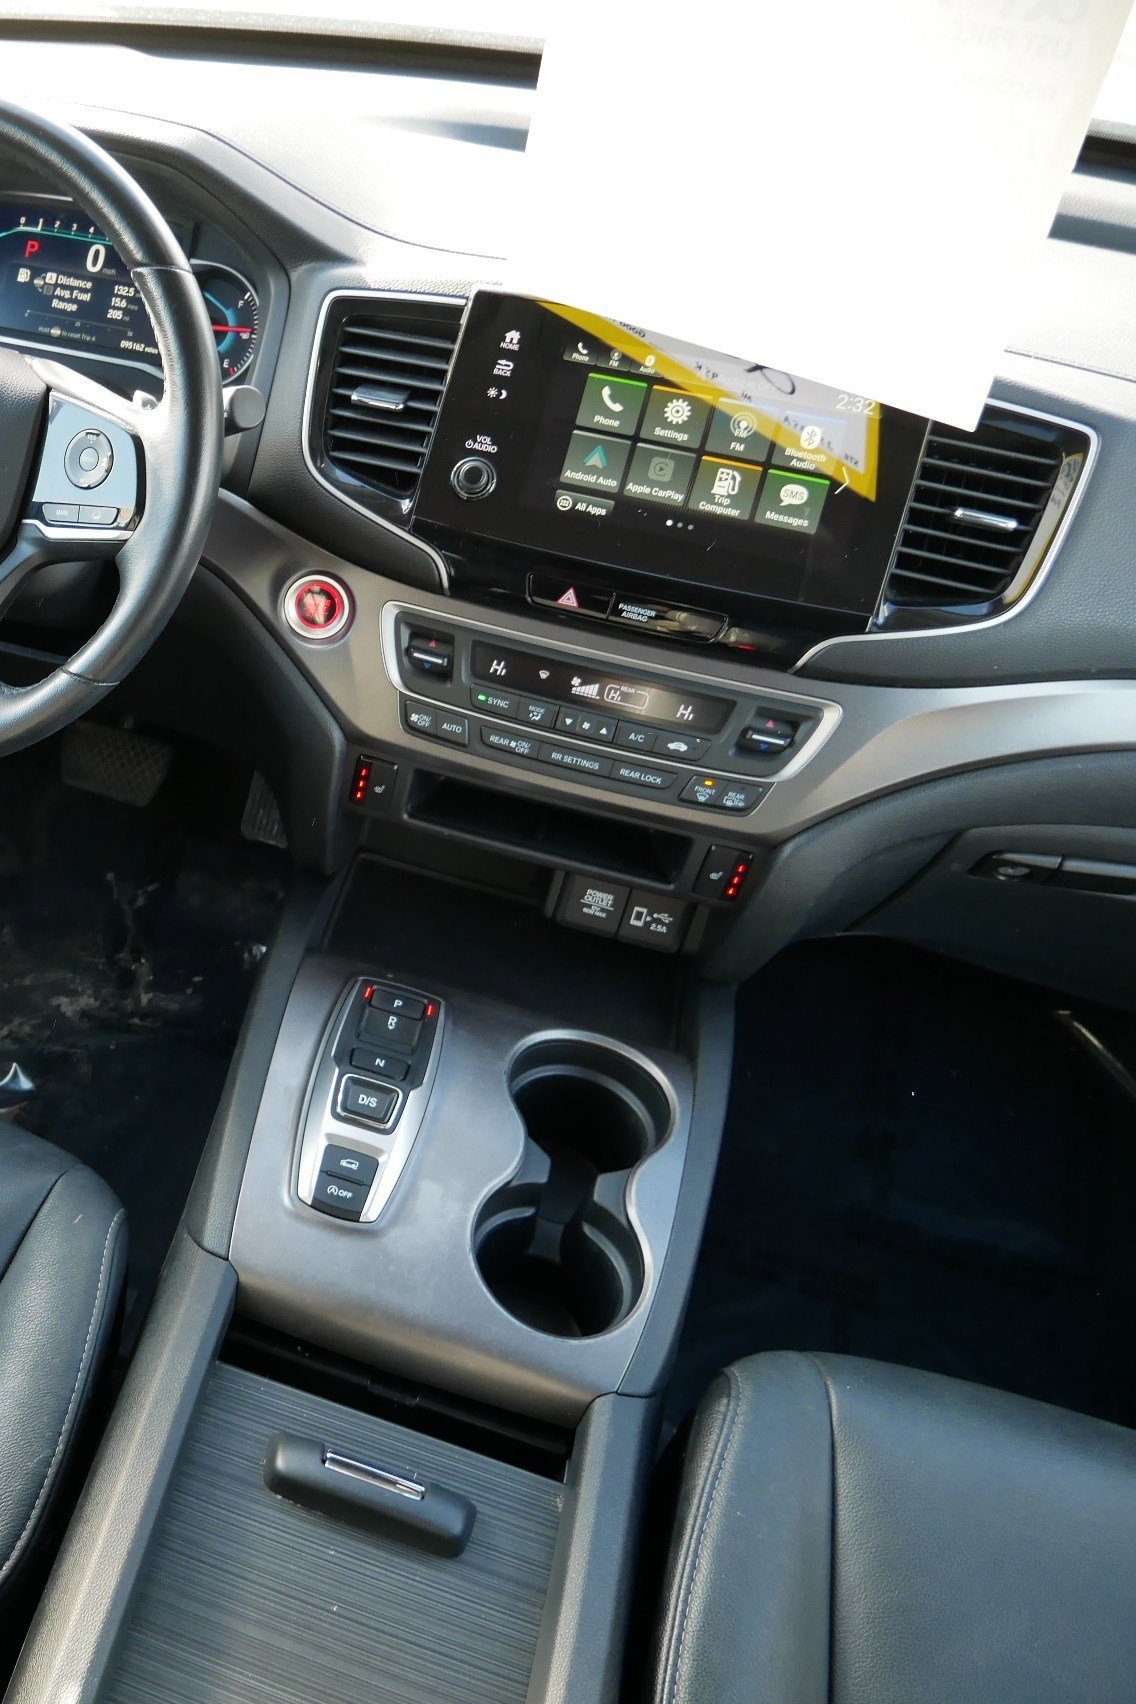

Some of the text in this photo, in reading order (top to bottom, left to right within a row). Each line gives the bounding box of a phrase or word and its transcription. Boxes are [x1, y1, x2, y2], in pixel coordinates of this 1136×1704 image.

[25, 240, 40, 258] P
[86, 244, 106, 273] 0
[57, 275, 93, 289] Distance
[114, 285, 135, 297] 132.5
[54, 287, 71, 299] Avg.
[72, 290, 91, 301] Fuel
[111, 297, 127, 308] 15.6
[52, 299, 78, 311] Range
[107, 309, 123, 320] 205
[238, 300, 244, 309] F
[120, 340, 145, 352] 095162
[500, 341, 520, 351] HOME
[571, 352, 590, 362] Phone
[223, 358, 229, 368] E
[608, 360, 619, 368] FM
[493, 368, 511, 377] BACK
[639, 365, 656, 374] Audio
[836, 394, 875, 415] 2:32
[593, 415, 620, 427] Phone
[654, 427, 689, 441] Settings
[476, 435, 492, 445] VOL
[472, 442, 498, 453] AUDIO
[729, 442, 745, 452] FM
[784, 447, 826, 462] Bluetooth
[790, 459, 816, 470] Audio
[564, 469, 617, 487] Android Auto
[626, 482, 684, 502] Apple CarPlay
[784, 489, 804, 501] SMS
[714, 495, 731, 506] Trip
[575, 502, 606, 516] All Apps
[699, 501, 740, 517] Computer
[765, 511, 809, 527] Messages
[618, 603, 656, 618] PASSENGER
[621, 611, 648, 622] AIRBAG
[621, 686, 636, 694] REAR
[487, 697, 509, 708] SYNC
[528, 705, 545, 714] MODE
[417, 720, 430, 728] OFF
[442, 722, 462, 734] AUTO
[489, 735, 509, 746] REAR
[628, 733, 645, 743] A/C
[515, 746, 530, 755] OFF
[551, 752, 600, 770] RR SETTINGS
[619, 768, 663, 784] REAR LOCK
[695, 785, 715, 795] FRONT
[728, 791, 745, 800] REAR
[587, 889, 614, 900] POWER
[584, 894, 612, 907] OUTLET
[650, 923, 667, 933] 2.5A
[393, 999, 402, 1009] P
[388, 1015, 397, 1026] R
[375, 1057, 385, 1067] N
[358, 1093, 377, 1108] D/S
[338, 1190, 353, 1200] OFF
